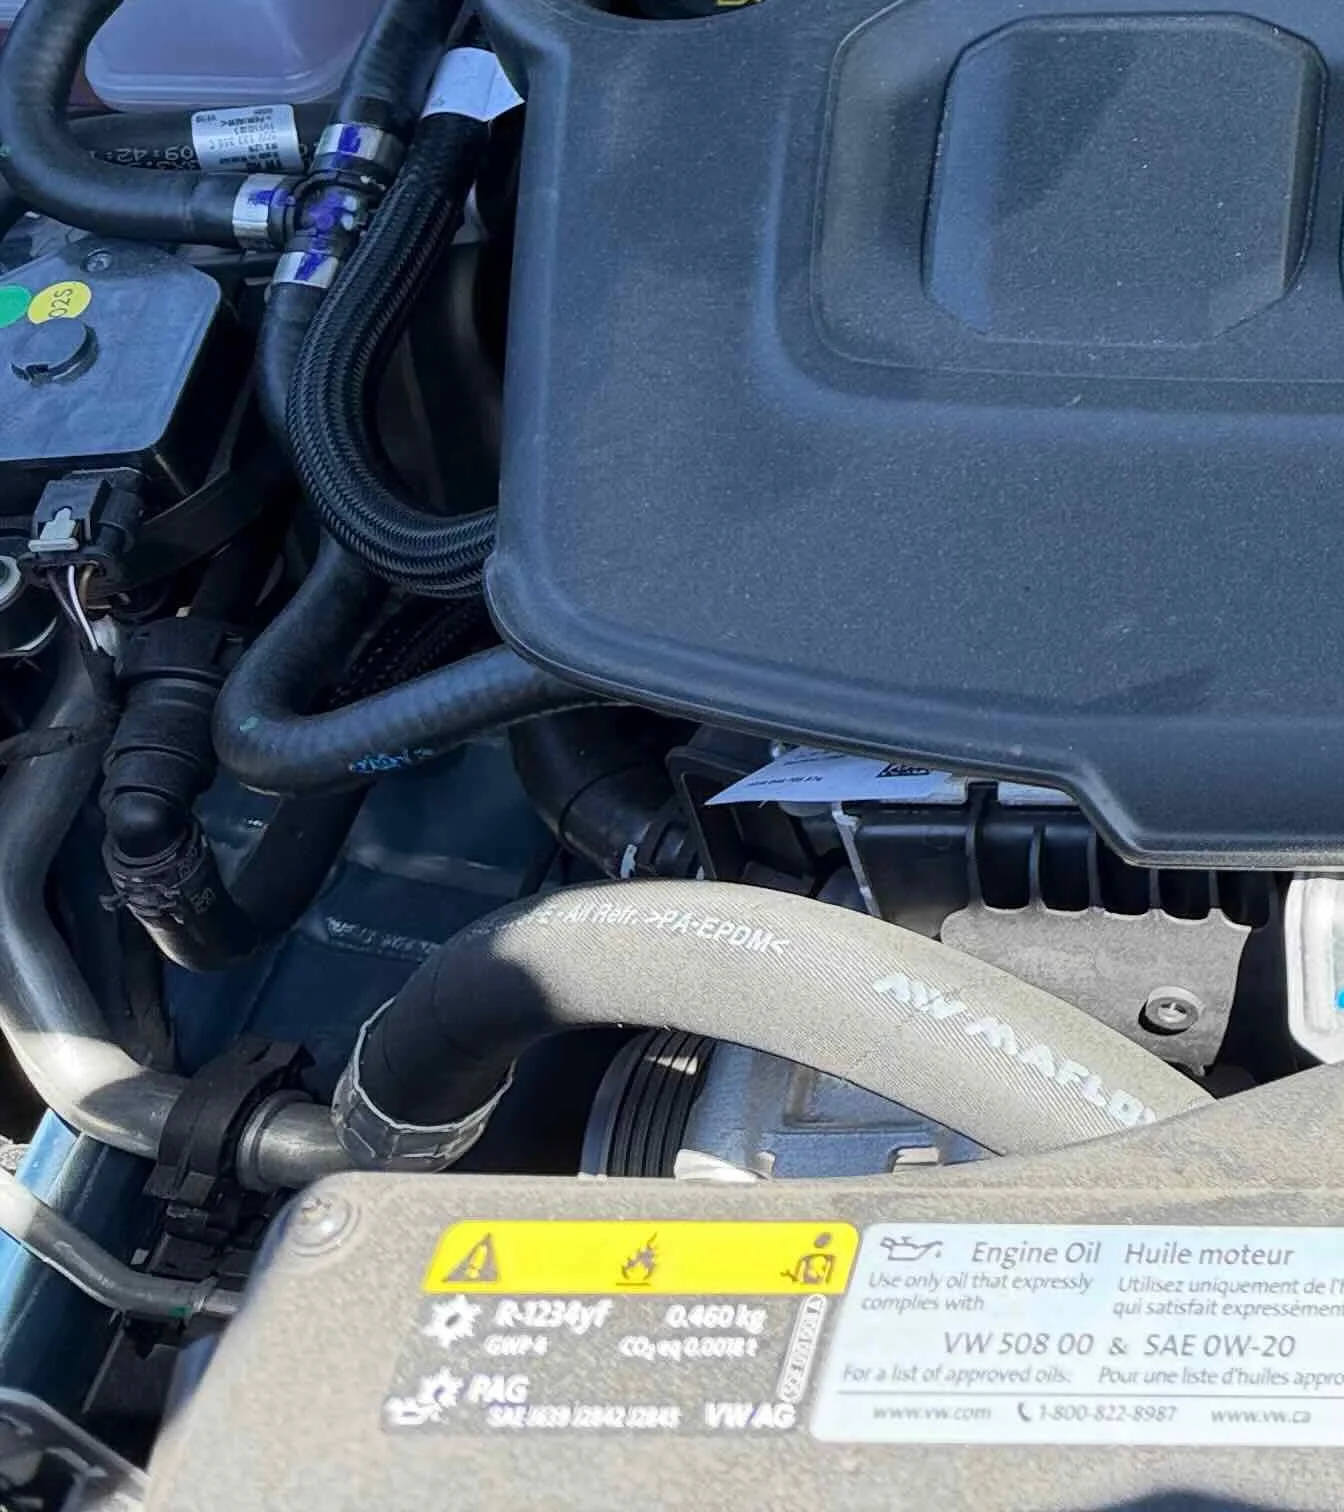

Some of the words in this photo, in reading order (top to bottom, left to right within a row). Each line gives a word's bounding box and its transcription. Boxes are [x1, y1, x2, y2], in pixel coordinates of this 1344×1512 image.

[971, 1241, 1058, 1270] Engine
[1064, 1241, 1102, 1264] Oil
[1124, 1242, 1192, 1266] Huile
[1199, 1245, 1295, 1266] moteur
[867, 1271, 903, 1288] Use
[904, 1272, 943, 1292] only
[947, 1271, 968, 1288] oil
[971, 1272, 1008, 1289] that
[1011, 1272, 1095, 1295] expressly
[1117, 1276, 1184, 1295] Utilisez
[1188, 1277, 1300, 1299] uniquement
[1302, 1276, 1326, 1296] de
[861, 1295, 939, 1315] complies
[944, 1295, 984, 1311] with
[1112, 1299, 1142, 1319] qui
[1145, 1297, 1218, 1317] satisfait
[943, 1332, 993, 1355] VW
[998, 1332, 1051, 1355] 508
[1056, 1332, 1095, 1356] 00
[1107, 1336, 1128, 1357] &
[1143, 1333, 1196, 1357] SAE
[1202, 1334, 1297, 1359] 0W-20
[842, 1364, 873, 1383] For
[874, 1368, 887, 1382] a
[890, 1364, 918, 1383] list
[922, 1364, 941, 1382] of
[943, 1364, 1031, 1387] approved
[1098, 1367, 1141, 1385] Pour
[1143, 1370, 1179, 1386] une
[1181, 1367, 1219, 1386] liste
[751, 1401, 797, 1429] AG
